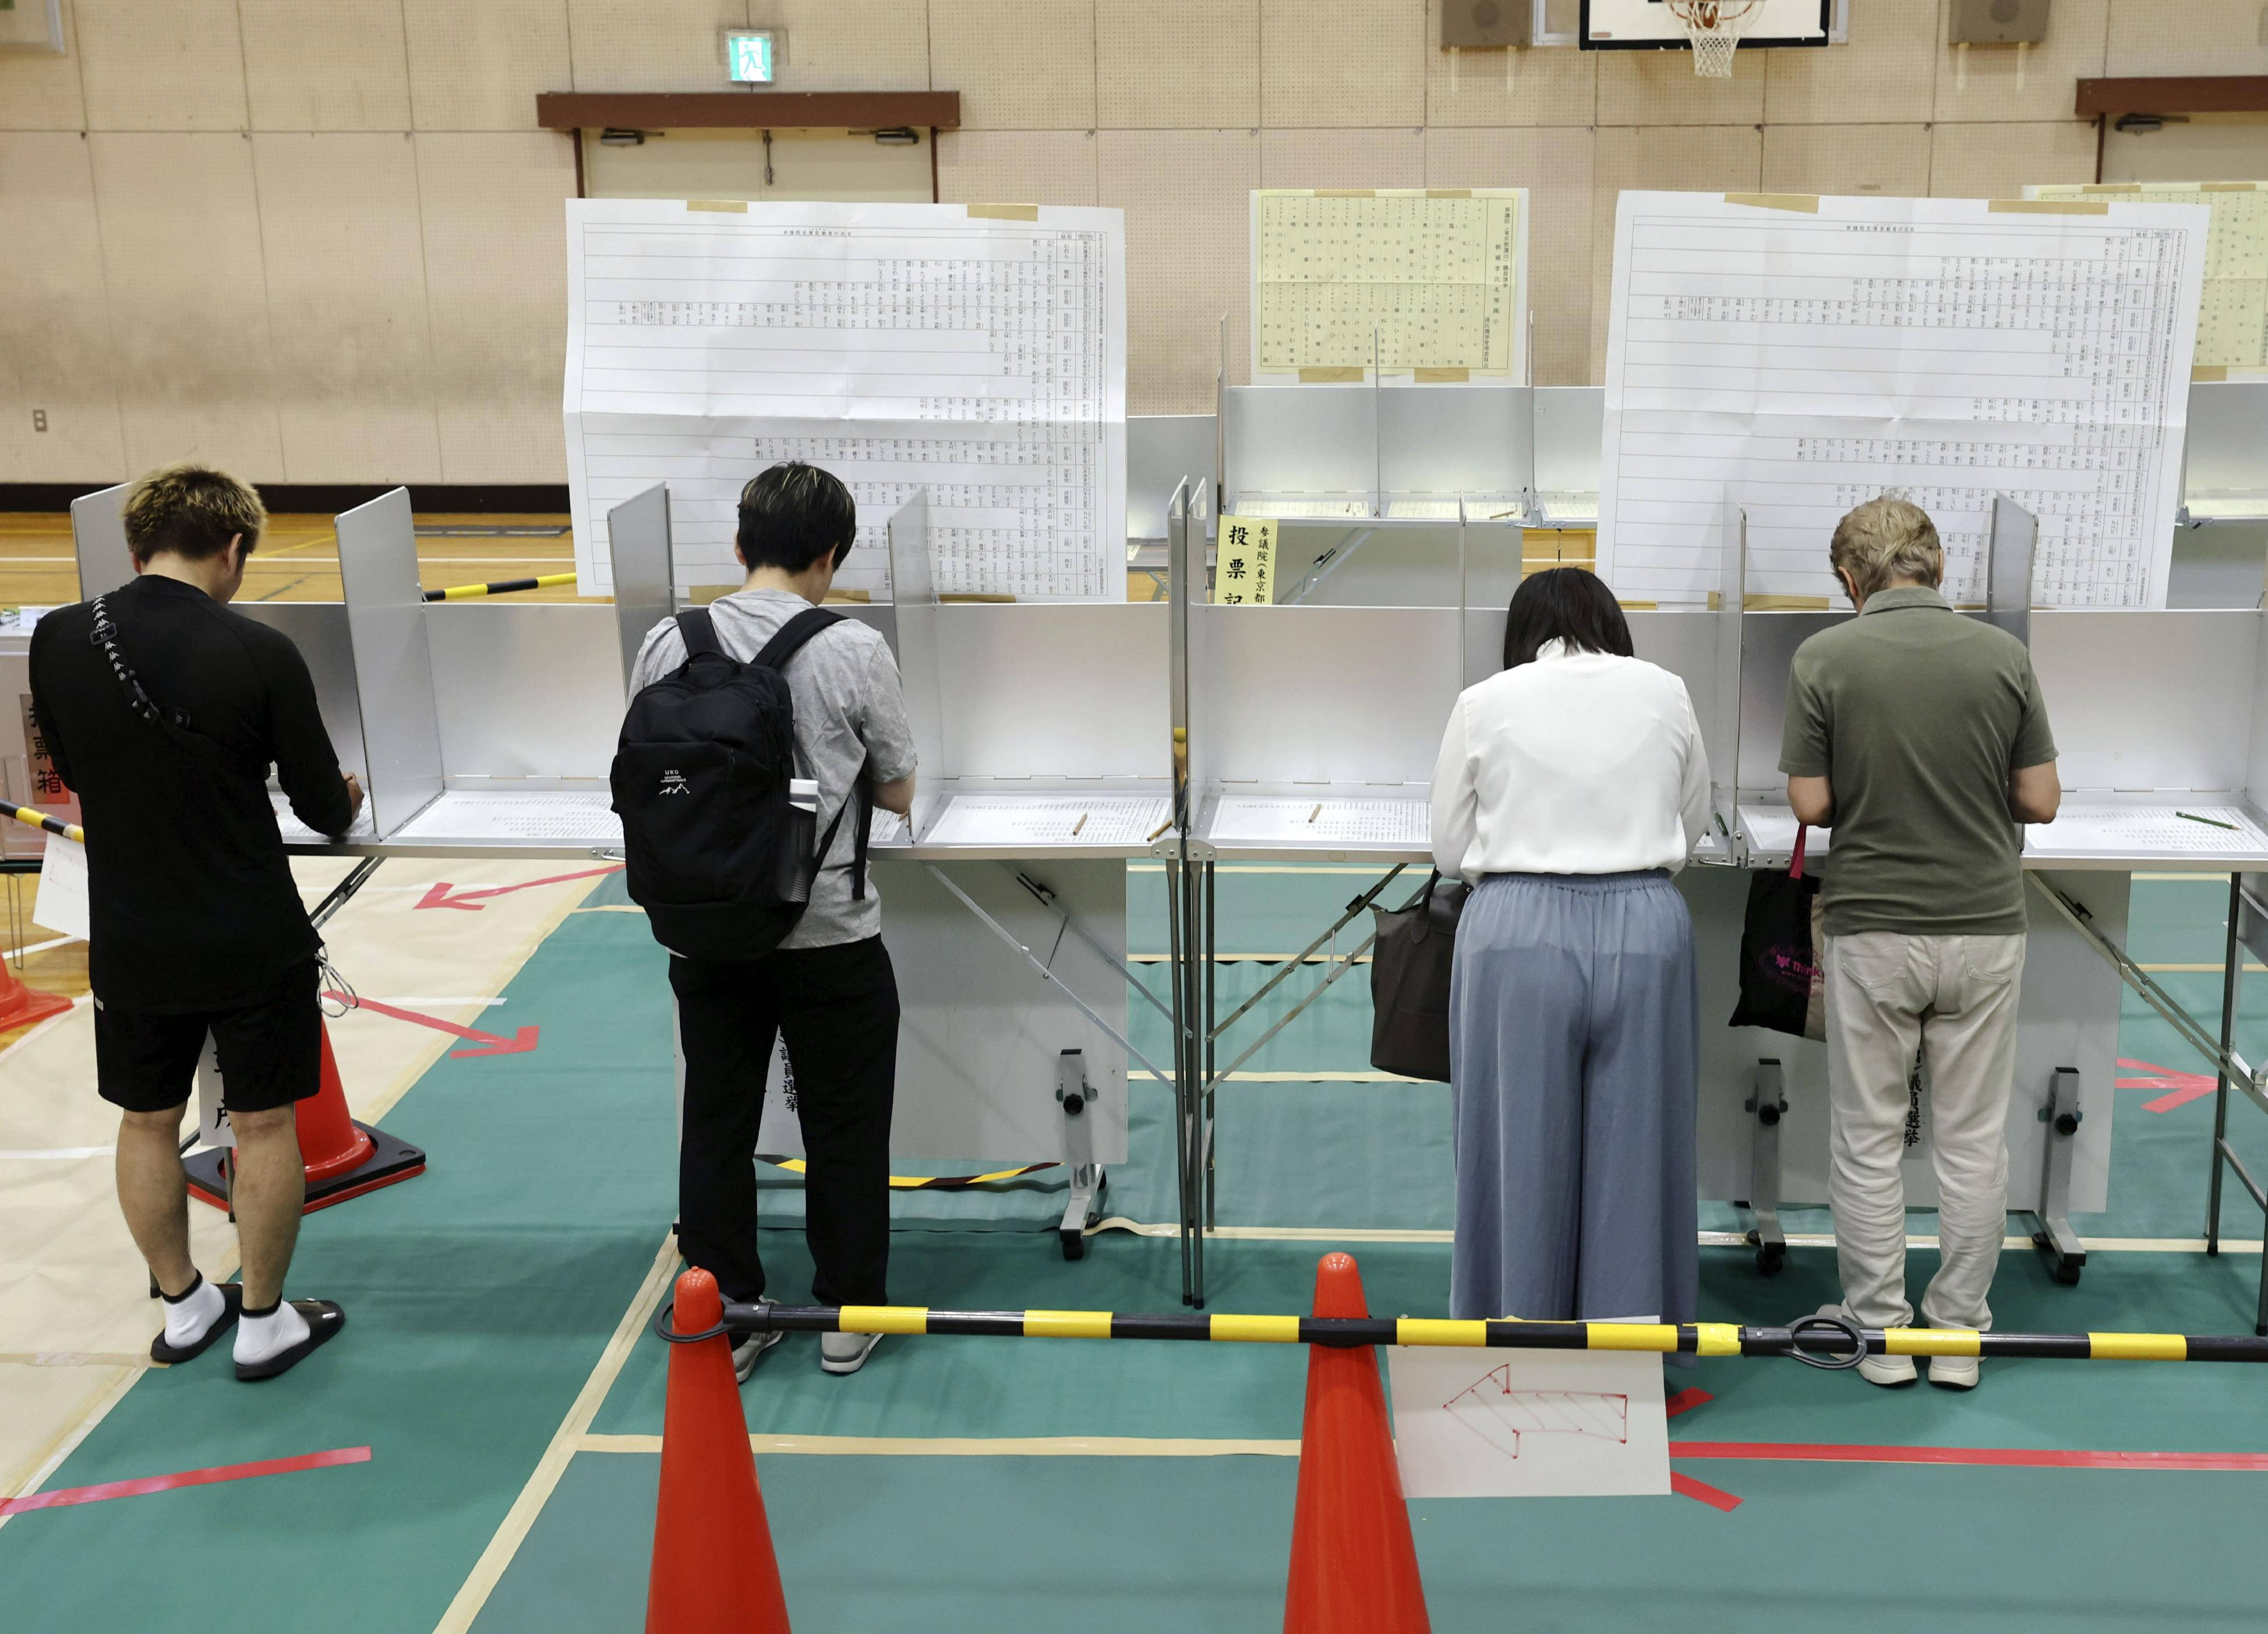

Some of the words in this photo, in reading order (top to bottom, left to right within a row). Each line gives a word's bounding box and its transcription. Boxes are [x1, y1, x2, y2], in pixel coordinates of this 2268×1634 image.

[1493, 243, 1502, 325] 候補者氏名等掲示
[1224, 525, 1249, 604] 投票記
[1255, 526, 1270, 604] 参議院（東京都
